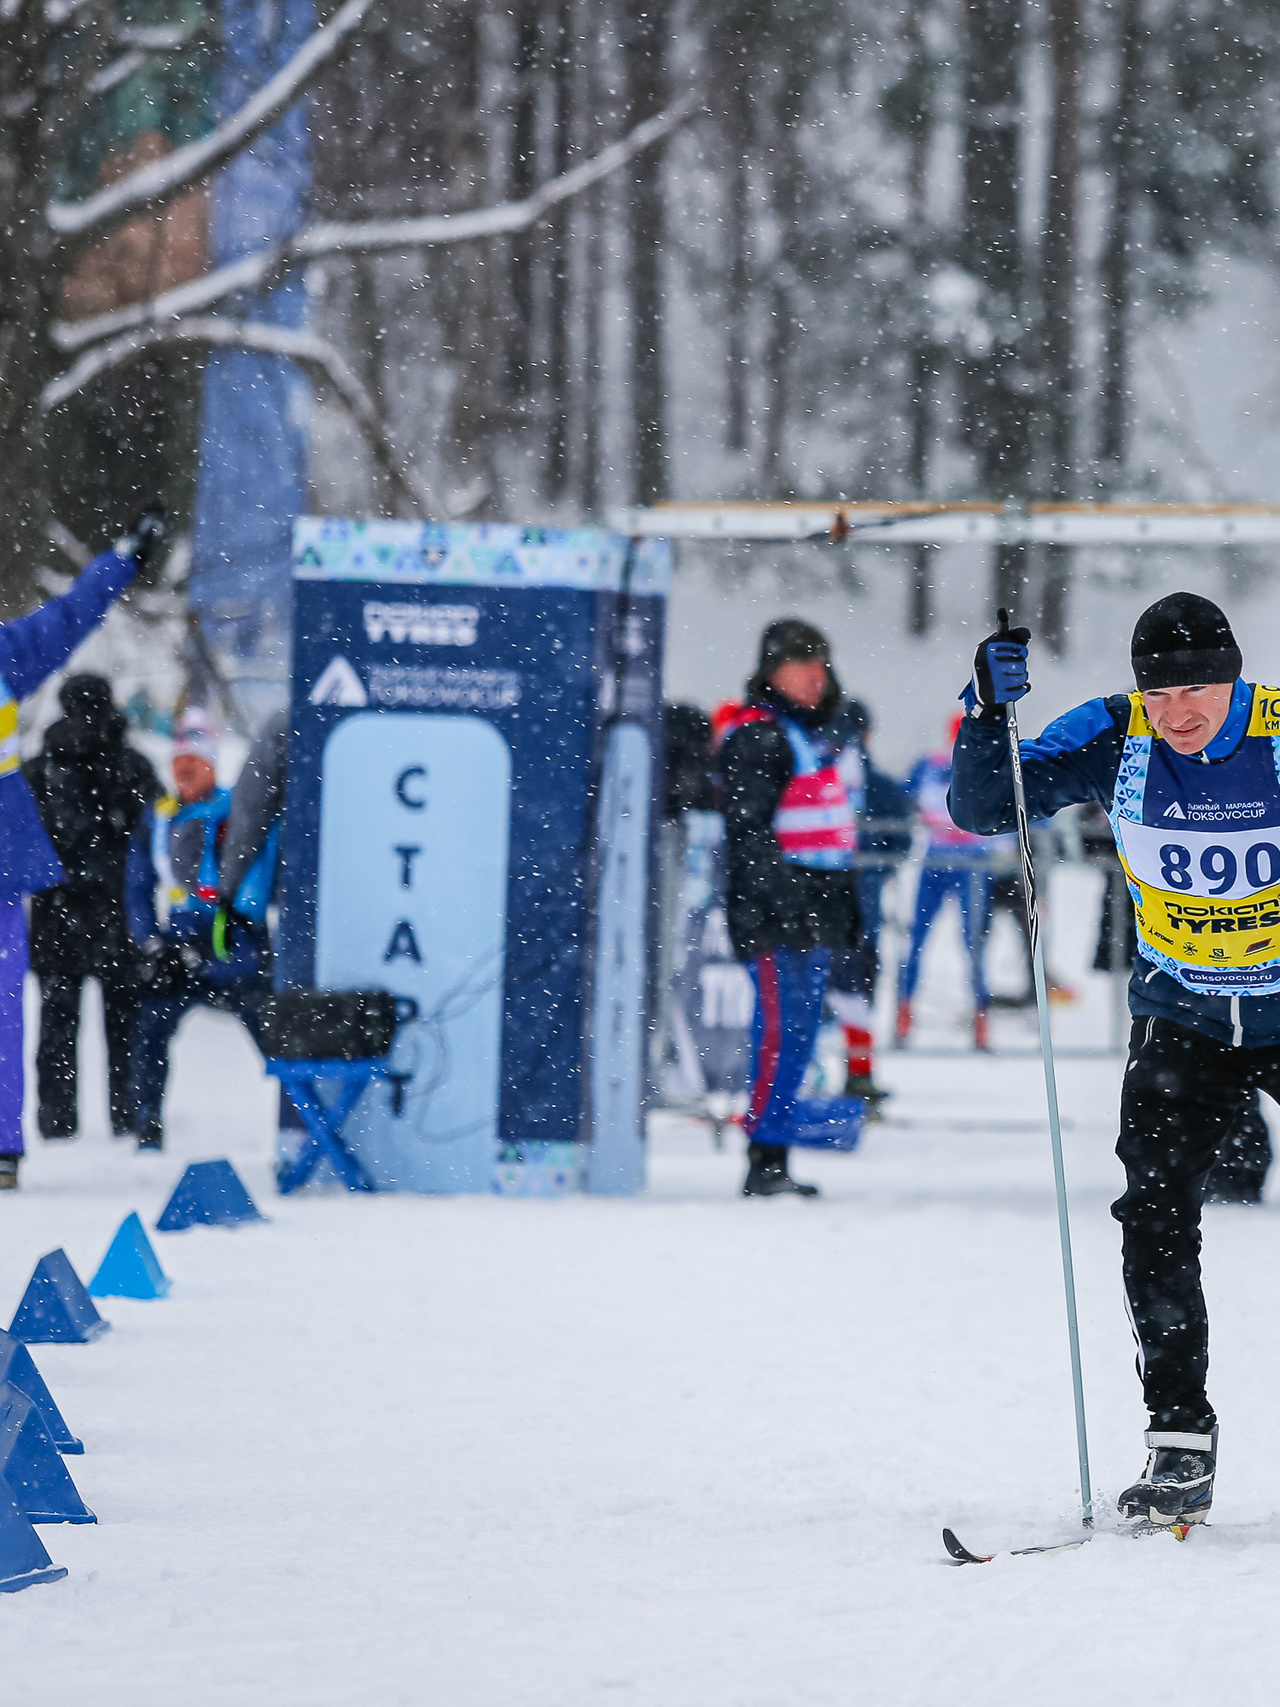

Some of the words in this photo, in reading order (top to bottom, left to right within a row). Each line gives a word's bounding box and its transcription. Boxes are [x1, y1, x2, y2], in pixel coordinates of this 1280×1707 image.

[1009, 730, 1022, 785] FISCHER
[1187, 802, 1220, 811] ЛЫЖНЫЙ
[1225, 801, 1264, 810] МАРАФОН
[1187, 809, 1266, 821] TOKSOVOCUP
[1189, 973, 1272, 983] toksovocup.ru
